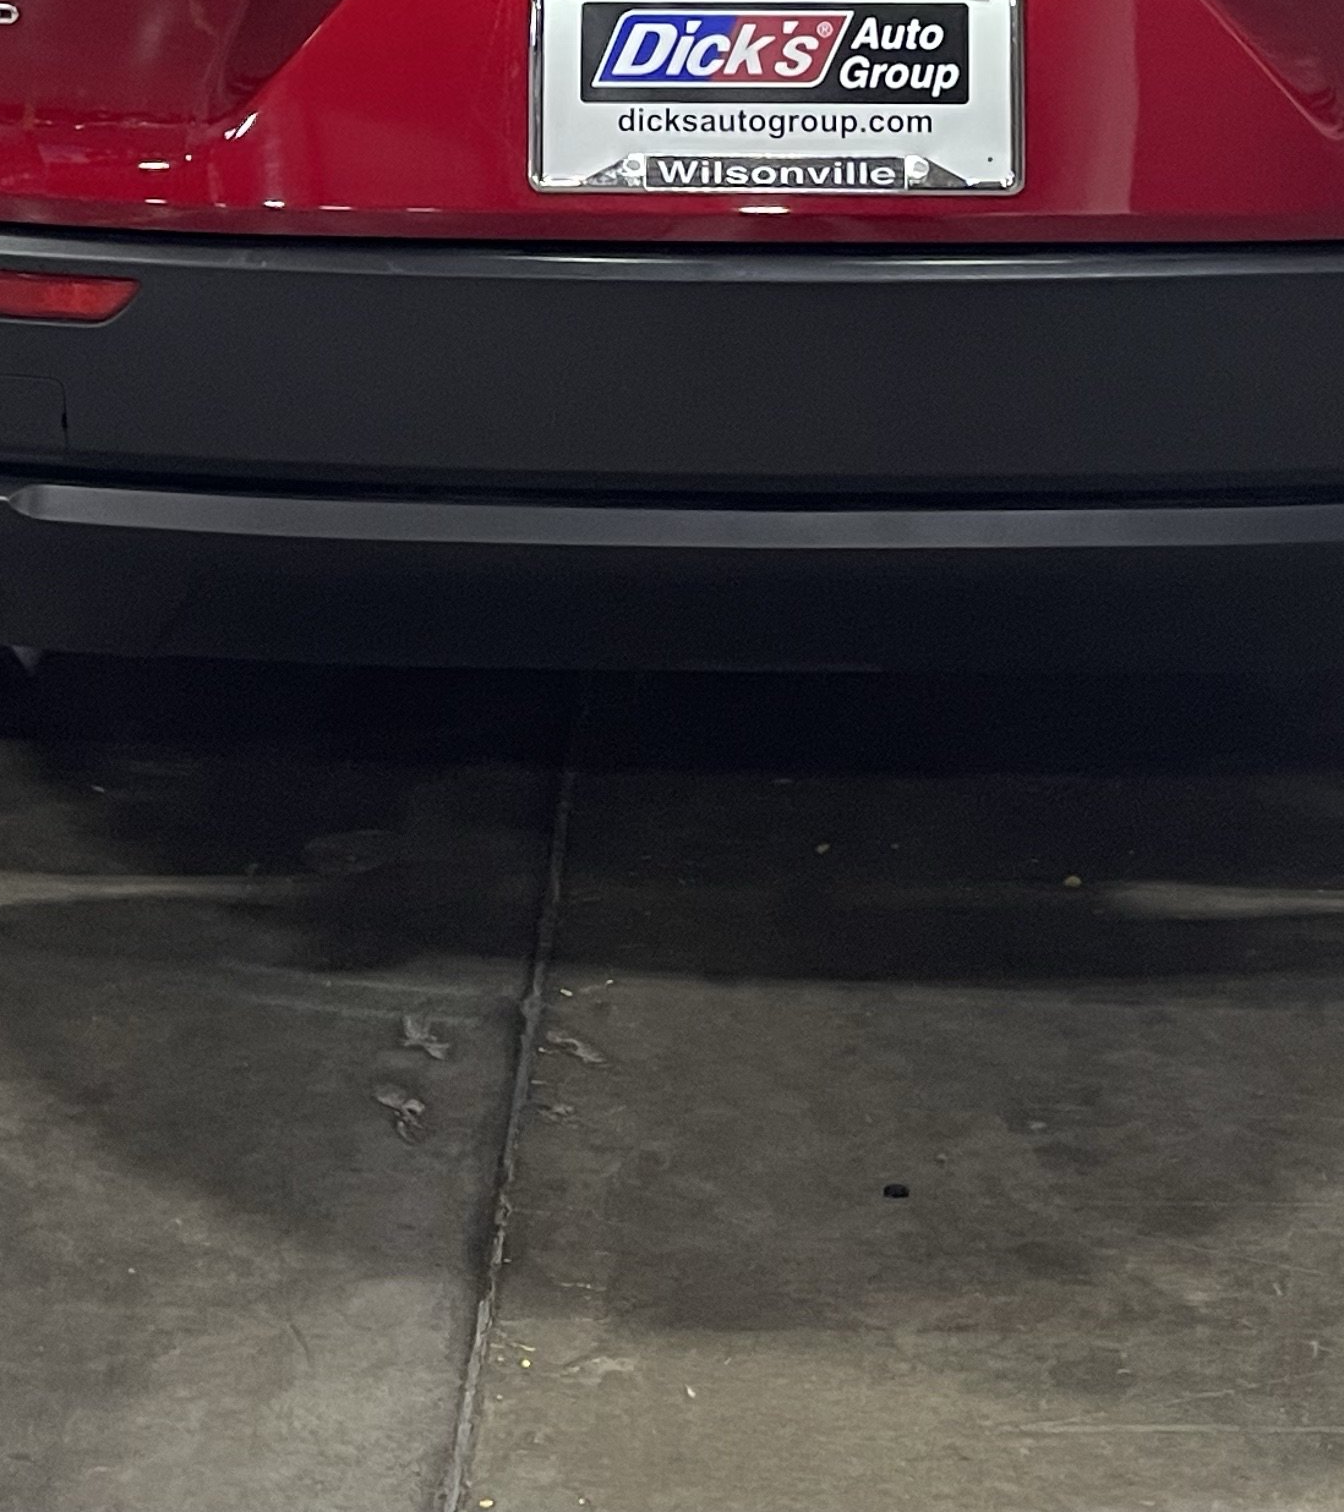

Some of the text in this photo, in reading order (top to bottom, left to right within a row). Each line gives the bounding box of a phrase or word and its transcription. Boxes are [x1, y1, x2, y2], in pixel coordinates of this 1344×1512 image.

[850, 16, 944, 50] Auto
[838, 56, 960, 98] Group
[618, 108, 933, 138] dicksautogroup.com
[657, 160, 897, 185] Wilsonville
